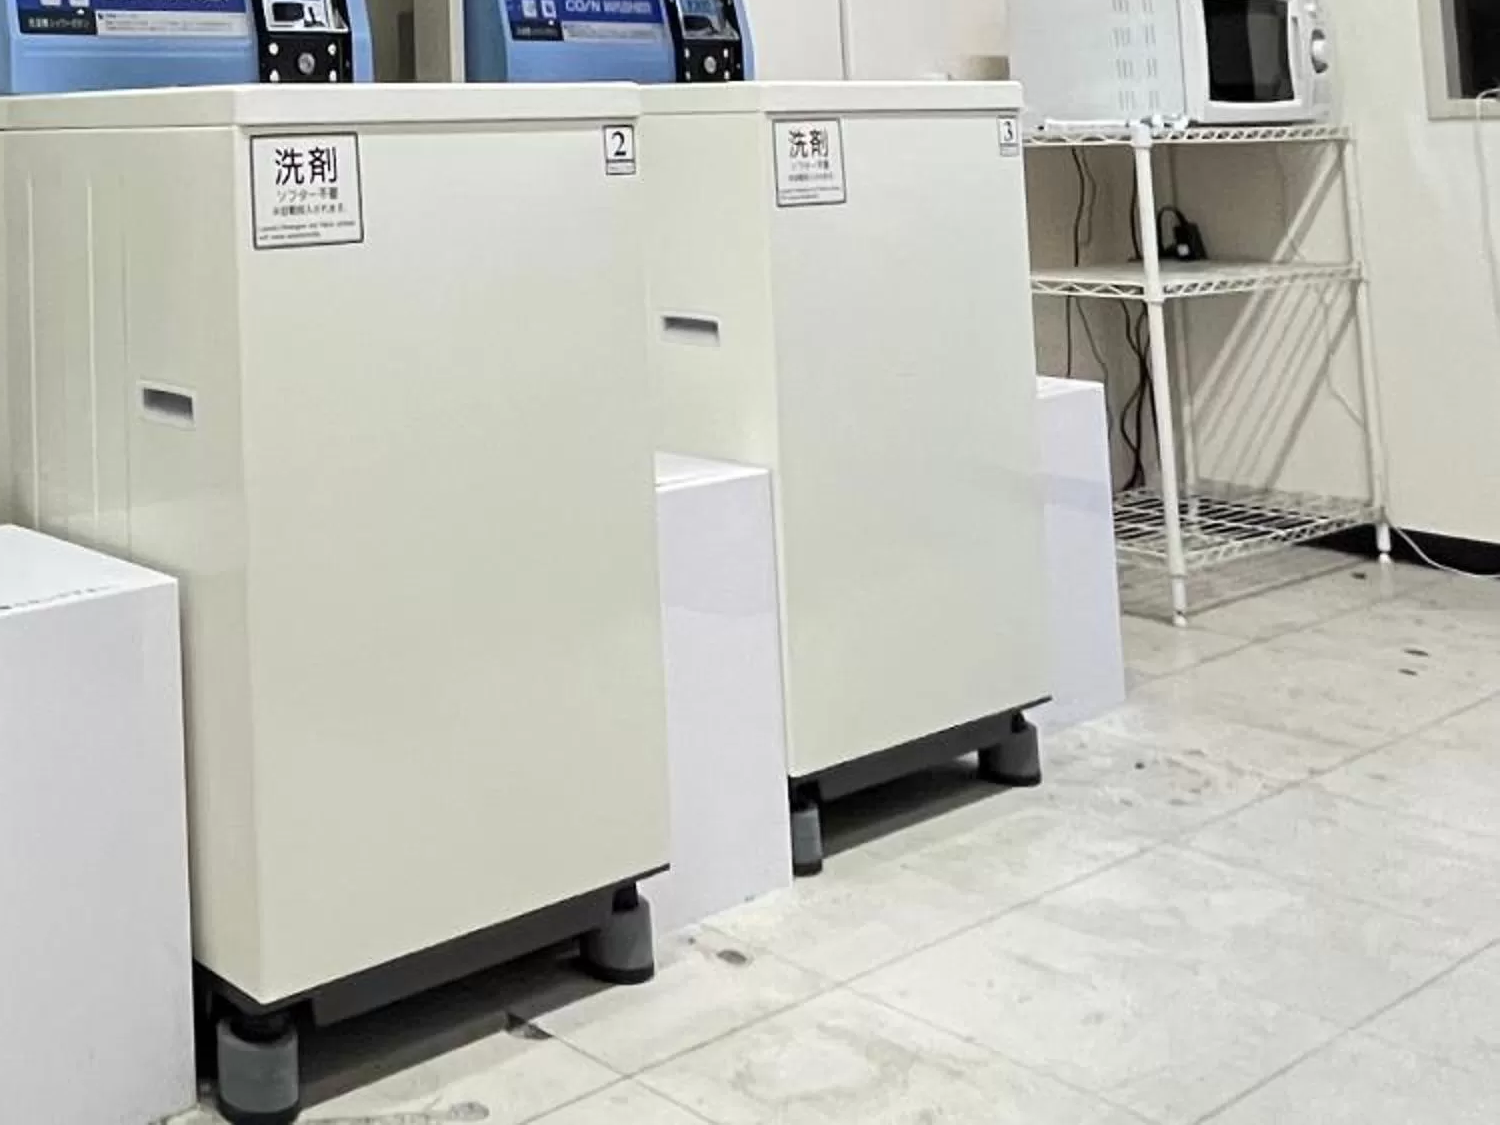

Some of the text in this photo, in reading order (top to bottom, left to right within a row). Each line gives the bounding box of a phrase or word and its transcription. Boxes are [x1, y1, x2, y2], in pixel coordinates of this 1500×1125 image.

[610, 130, 627, 157] 2
[1003, 120, 1013, 142] 3
[274, 146, 339, 186] 洗剤
